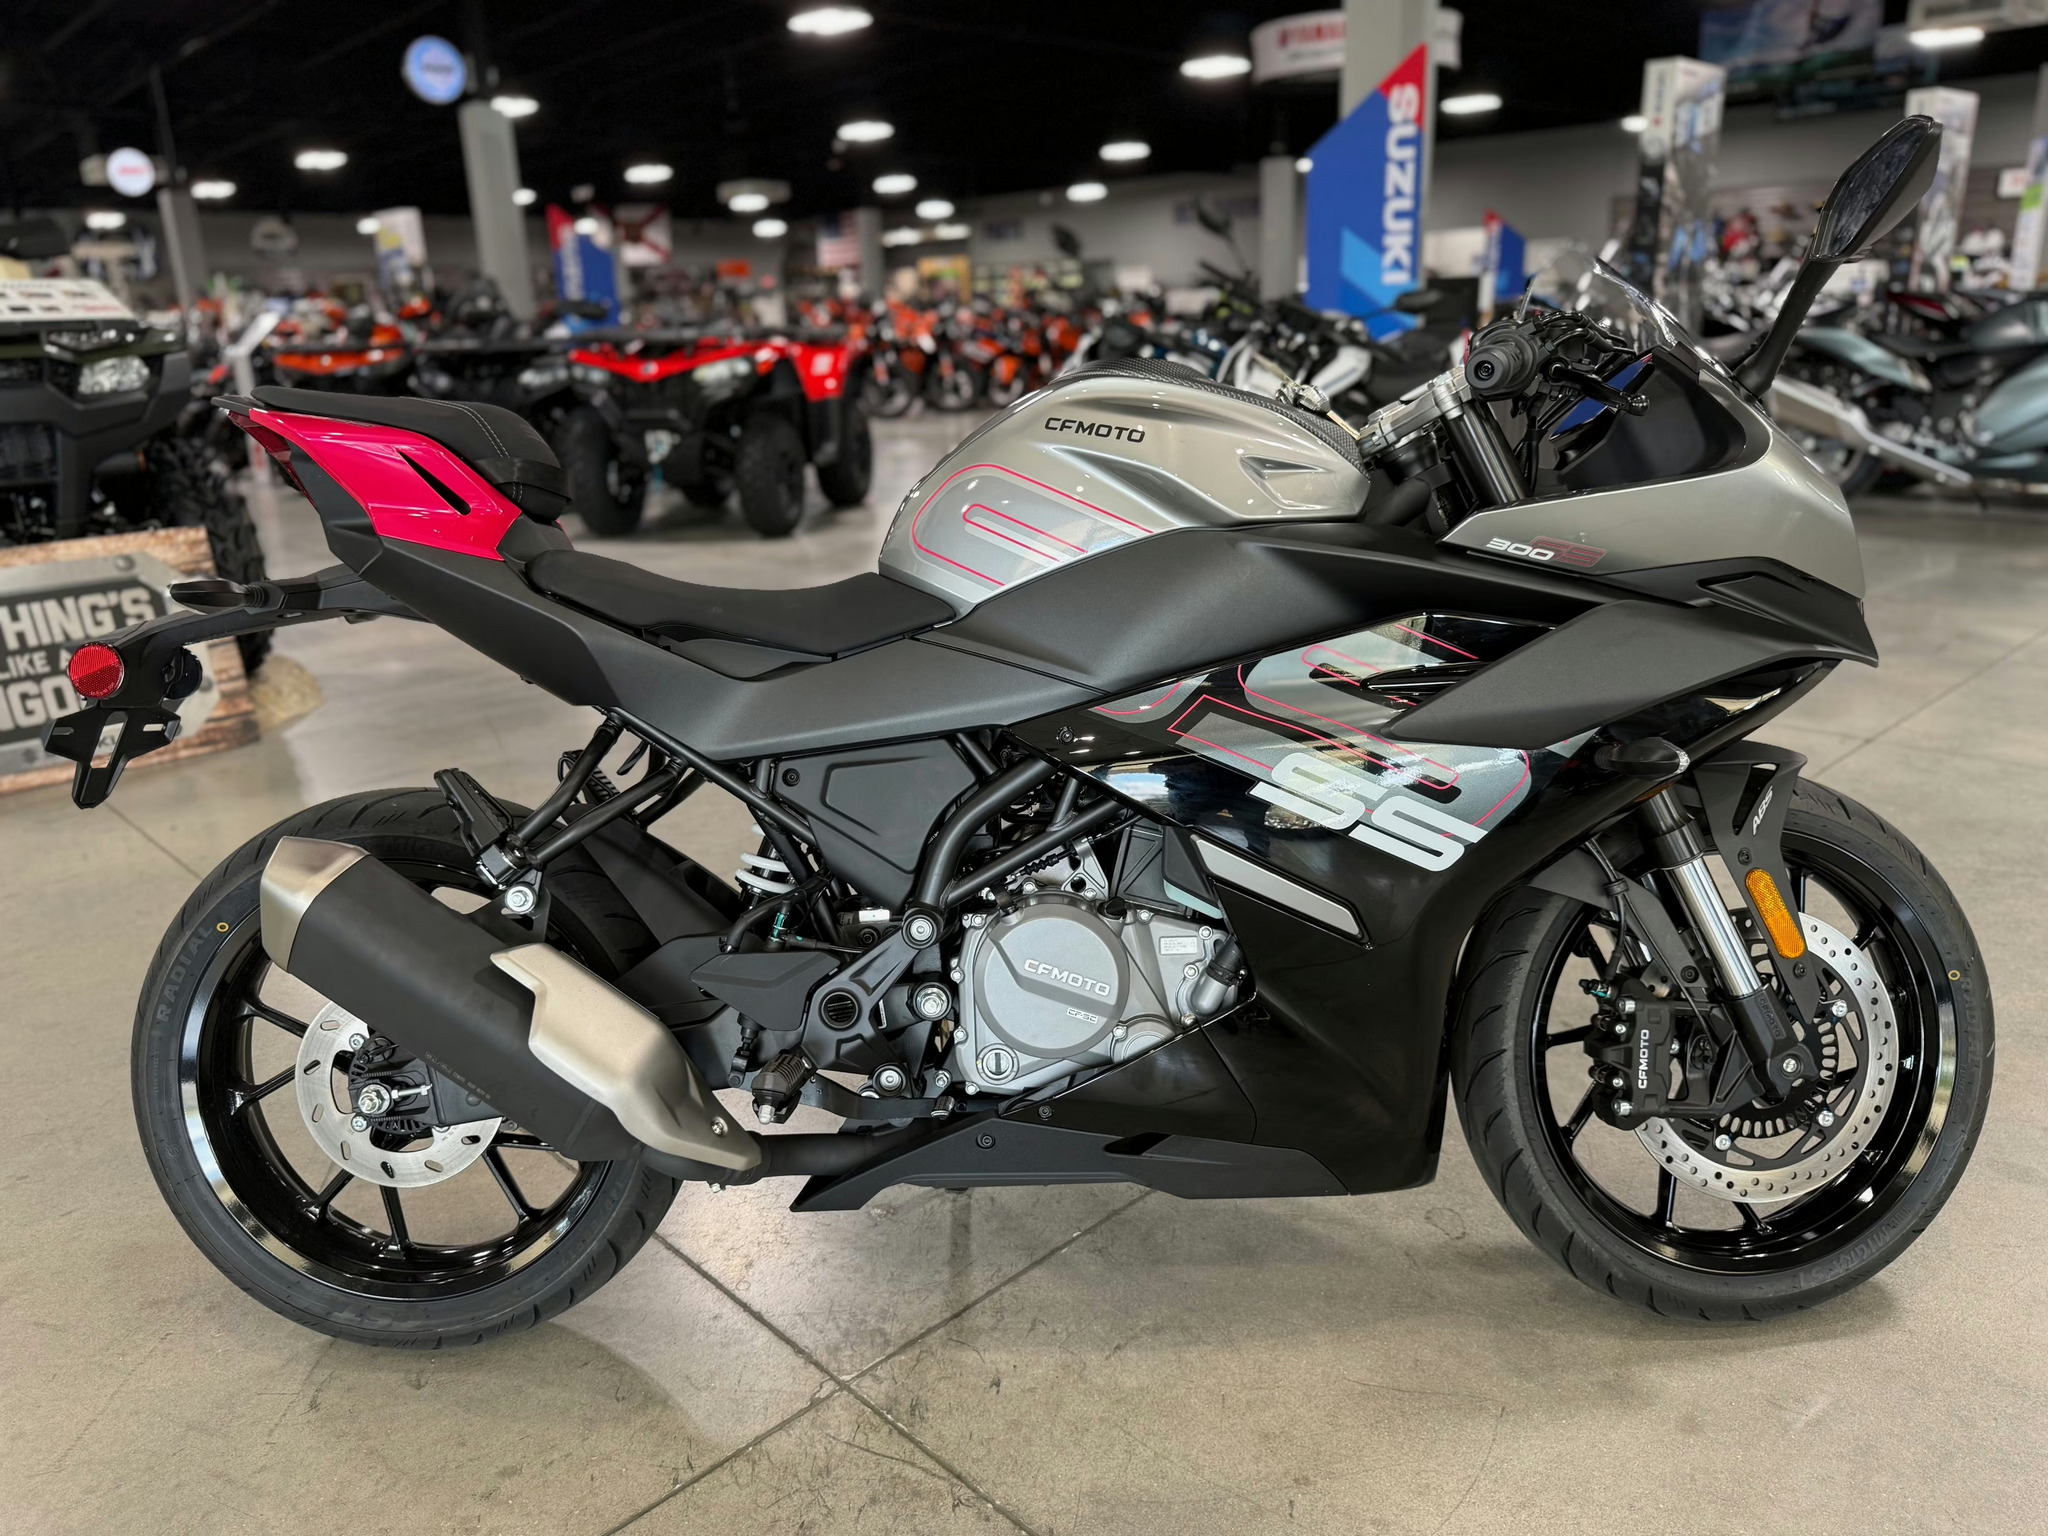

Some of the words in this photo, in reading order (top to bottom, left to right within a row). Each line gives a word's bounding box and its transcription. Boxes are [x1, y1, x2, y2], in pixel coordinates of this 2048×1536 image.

[1381, 83, 1420, 286] SUZUKI
[1044, 417, 1146, 443] CFMOTO
[1752, 785, 1773, 836] ABS
[155, 922, 214, 1023] RADIAL
[1024, 958, 1111, 997] CFMOTO
[1637, 1029, 1650, 1090] CFMOTO
